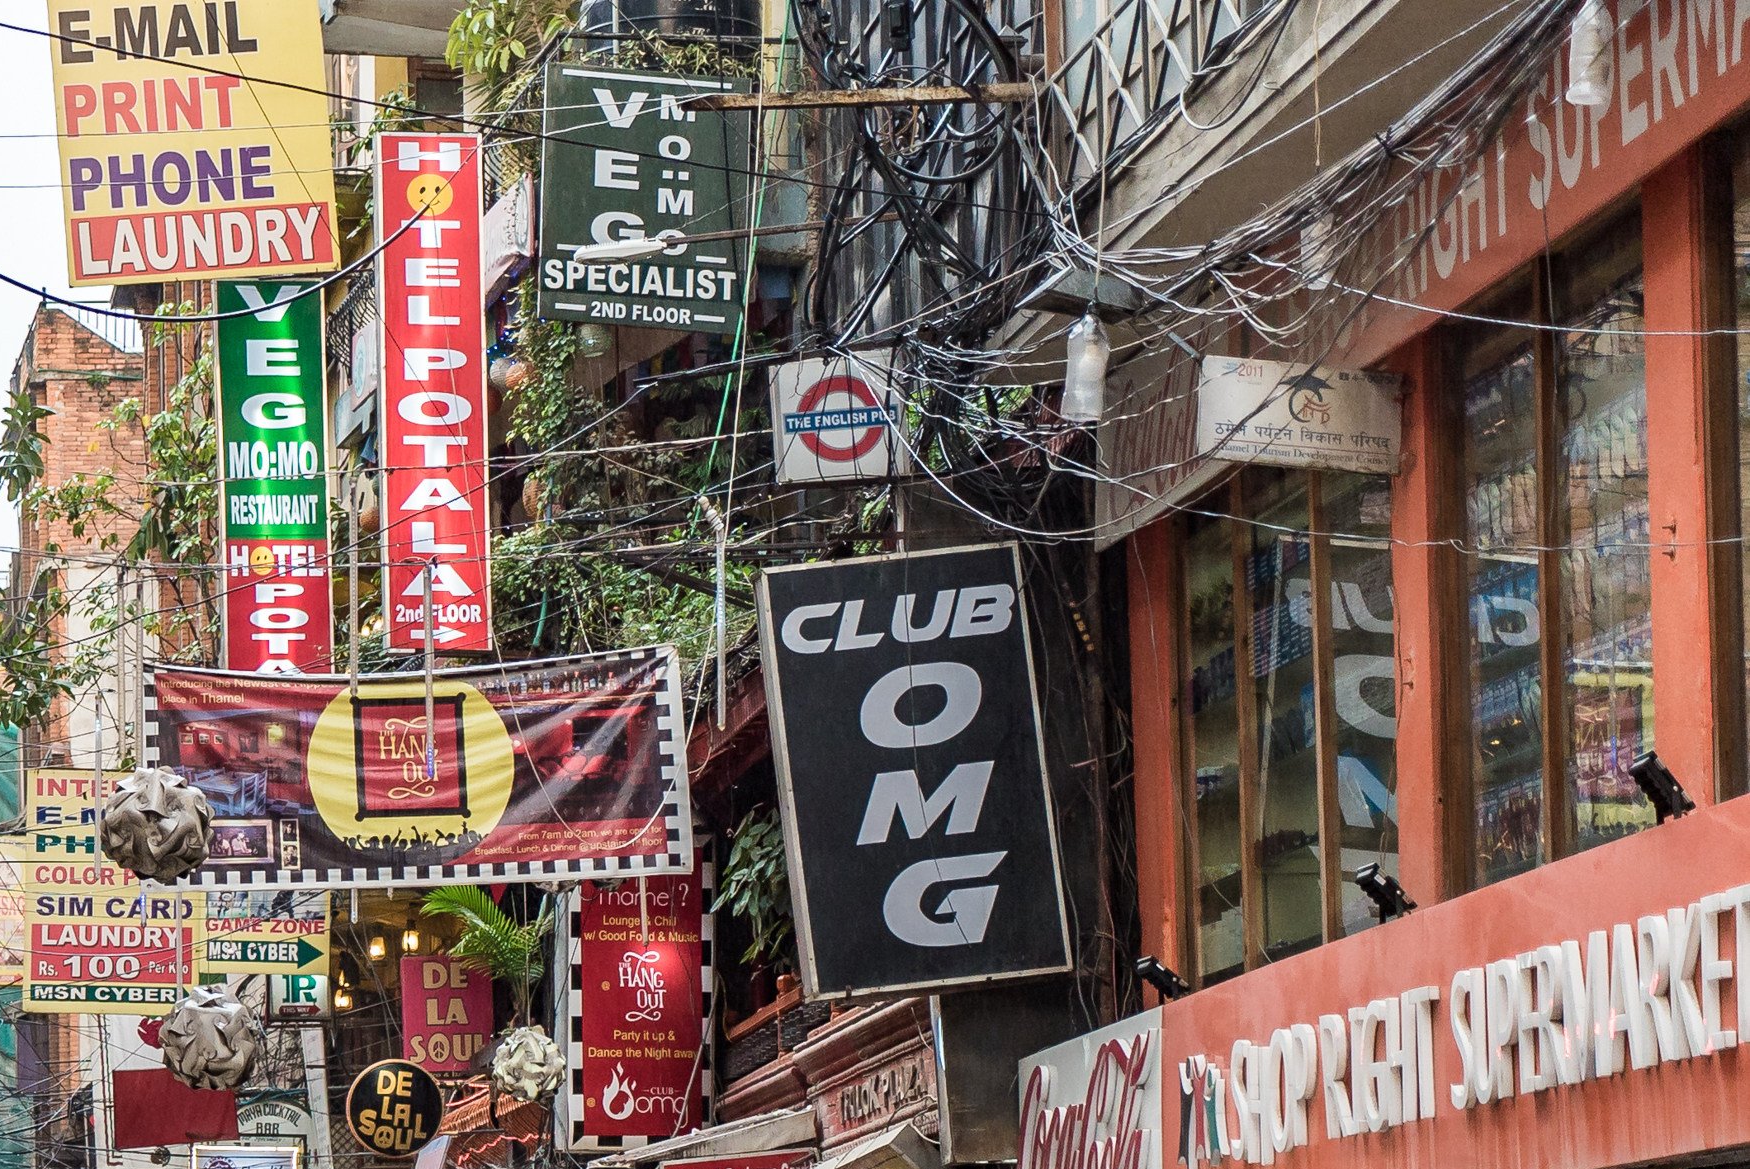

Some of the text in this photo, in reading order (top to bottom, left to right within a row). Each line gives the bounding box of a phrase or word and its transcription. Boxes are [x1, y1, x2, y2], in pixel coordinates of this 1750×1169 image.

[60, 0, 259, 64] E-MAIL
[62, 75, 241, 137] PRINT
[68, 145, 276, 212] PHONE
[78, 206, 322, 277] LAUNDRY
[543, 259, 737, 300] SPECIALIST
[590, 303, 691, 325] 2ND FLOOR
[236, 285, 312, 430] VEG
[786, 411, 868, 429] THE ENGLISH
[1300, 427, 1344, 446] विकास
[227, 440, 318, 480] MO:MO
[229, 492, 318, 527] RESTAURANT
[396, 603, 424, 623] 2nd
[781, 584, 1014, 655] CLUB
[201, 692, 245, 704] Thamel
[856, 661, 1009, 948] OMG
[34, 866, 120, 886] COLOR
[36, 896, 194, 920] SIM CARD
[206, 917, 325, 934] GAME ZONE
[602, 915, 641, 930] Lounge
[40, 924, 179, 949] LAUNDRY
[598, 930, 699, 942] Good Music
[208, 940, 299, 962] MSN CYBER
[63, 955, 141, 980] 100
[422, 962, 469, 990] DE
[34, 985, 176, 1003] MSN CYBER
[1450, 884, 1750, 1109] SUPERMARKET
[426, 998, 469, 1025] LA
[613, 1030, 641, 1044] Party
[588, 1047, 623, 1058] Dance
[1319, 986, 1440, 1141] RIGHT
[377, 1070, 413, 1098] DE
[650, 1086, 674, 1095] CLUB
[1230, 1023, 1317, 1165] SHOP
[262, 1102, 302, 1128] COCKTAIL
[256, 1121, 280, 1135] BAR
